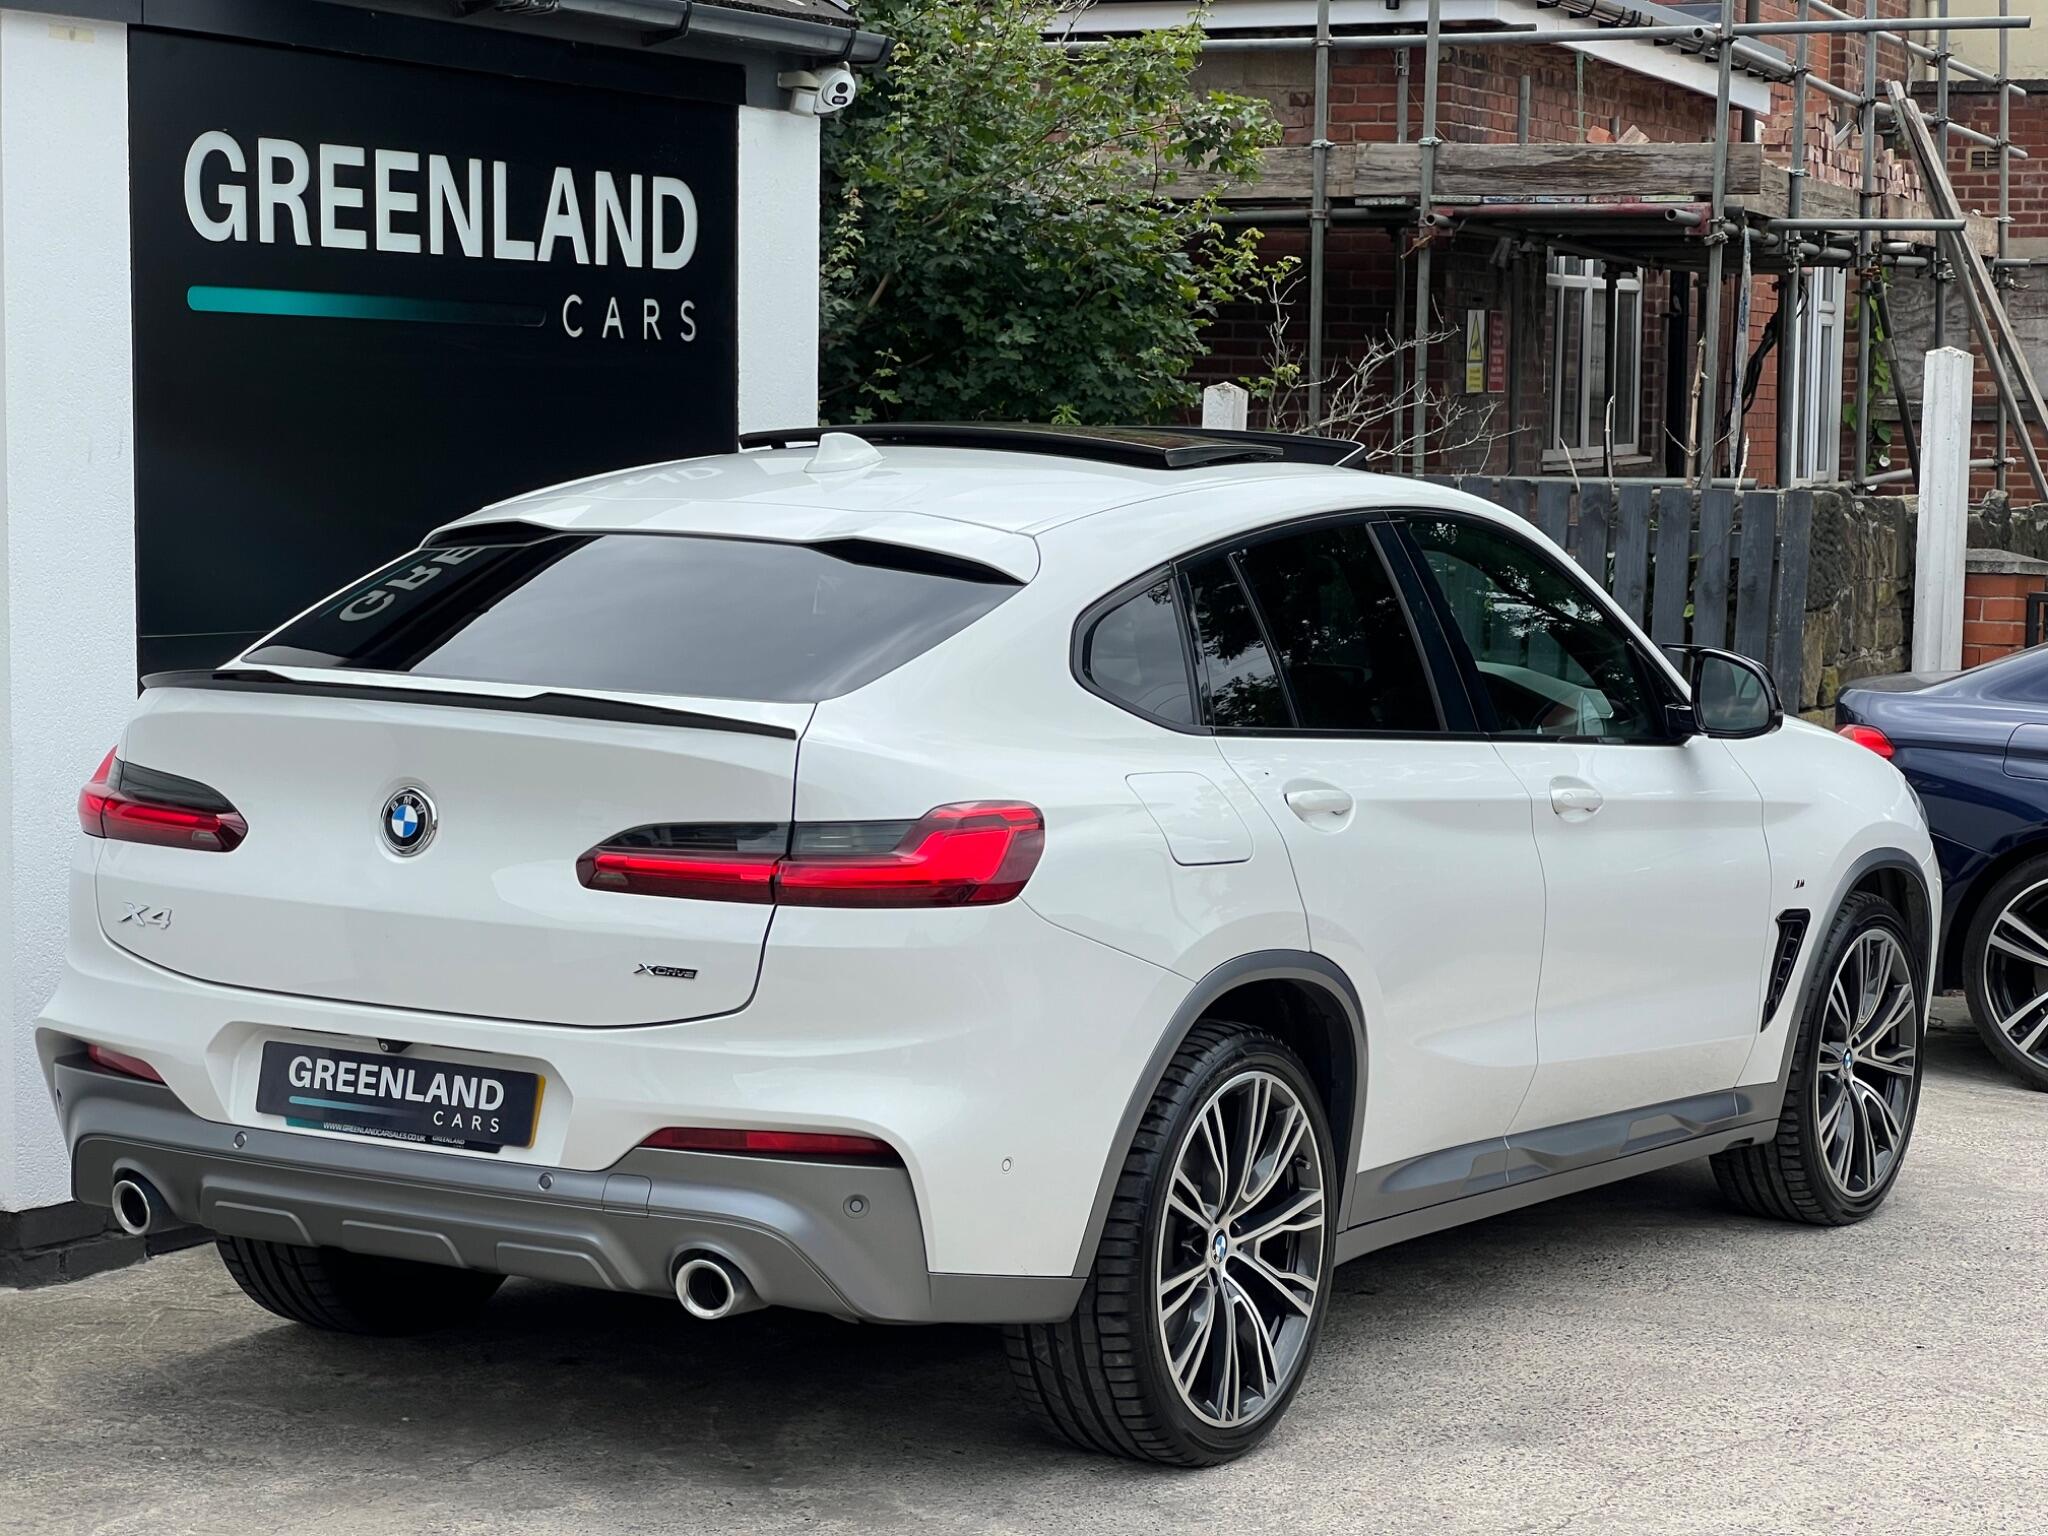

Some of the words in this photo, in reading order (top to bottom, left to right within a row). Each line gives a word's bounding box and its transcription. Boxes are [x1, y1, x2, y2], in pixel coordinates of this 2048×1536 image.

[184, 130, 698, 271] GREENLAND
[562, 294, 697, 342] CARS
[391, 796, 425, 815] BMW
[118, 901, 172, 930] X4
[288, 1056, 504, 1111] GREENLAND
[433, 1110, 500, 1133] CARS
